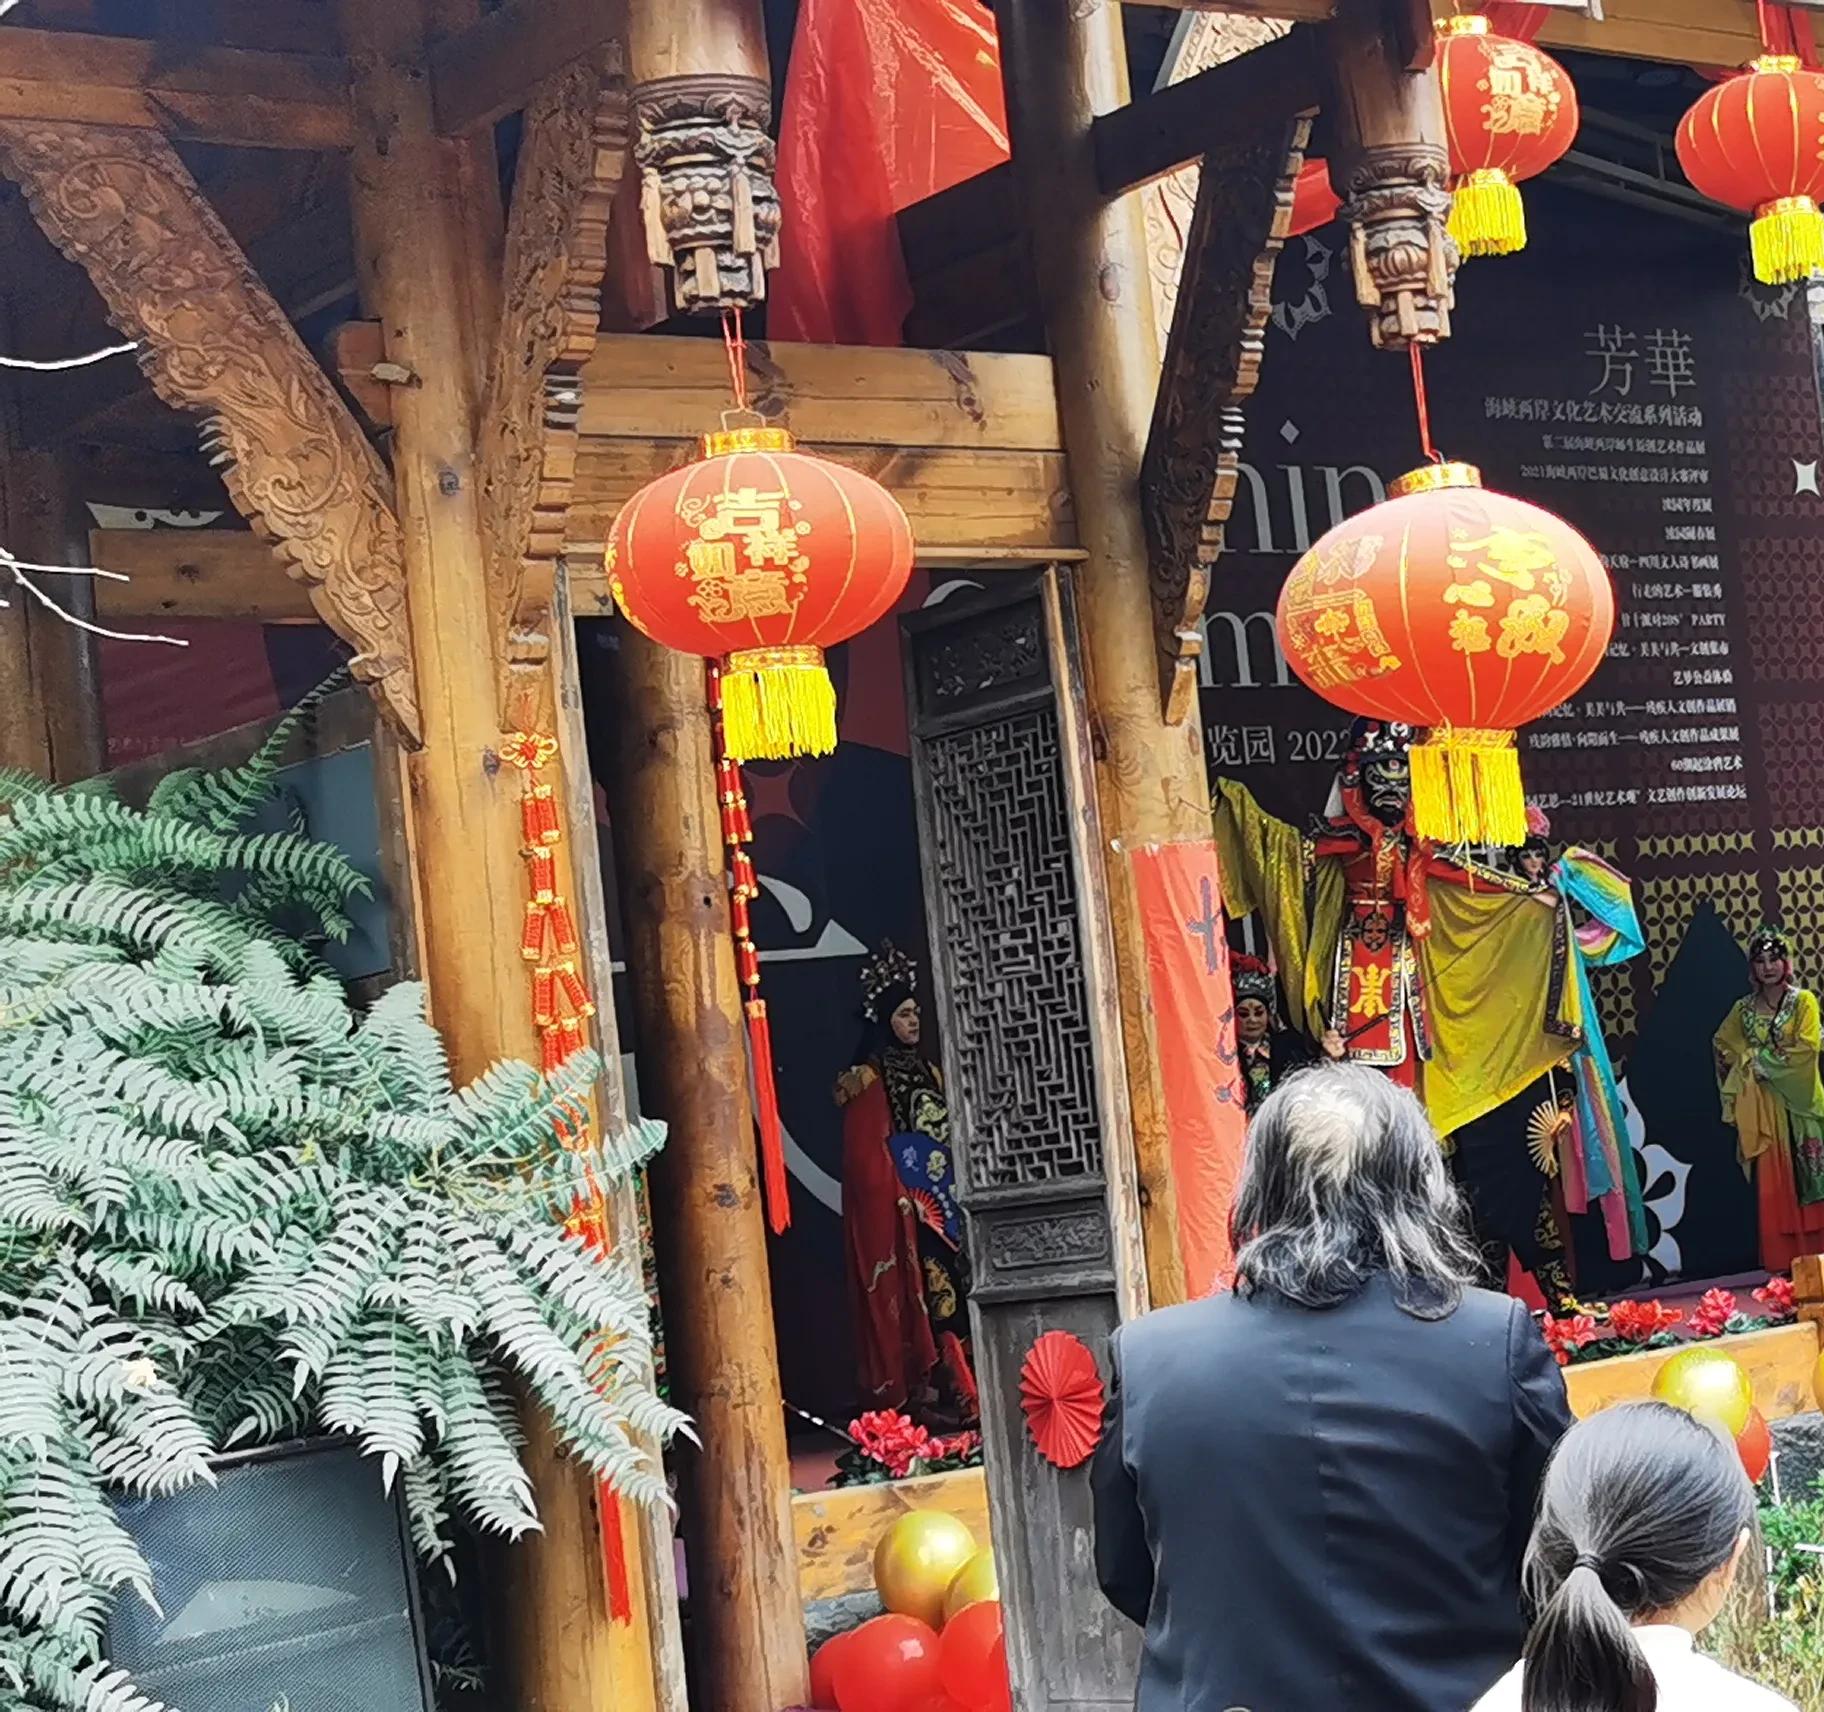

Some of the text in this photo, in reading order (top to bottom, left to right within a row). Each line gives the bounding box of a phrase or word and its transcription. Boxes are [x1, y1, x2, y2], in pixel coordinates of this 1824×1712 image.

[1583, 323, 1697, 399] 芳華
[1691, 613, 1727, 627] PARTY
[1208, 724, 1276, 768] 览园
